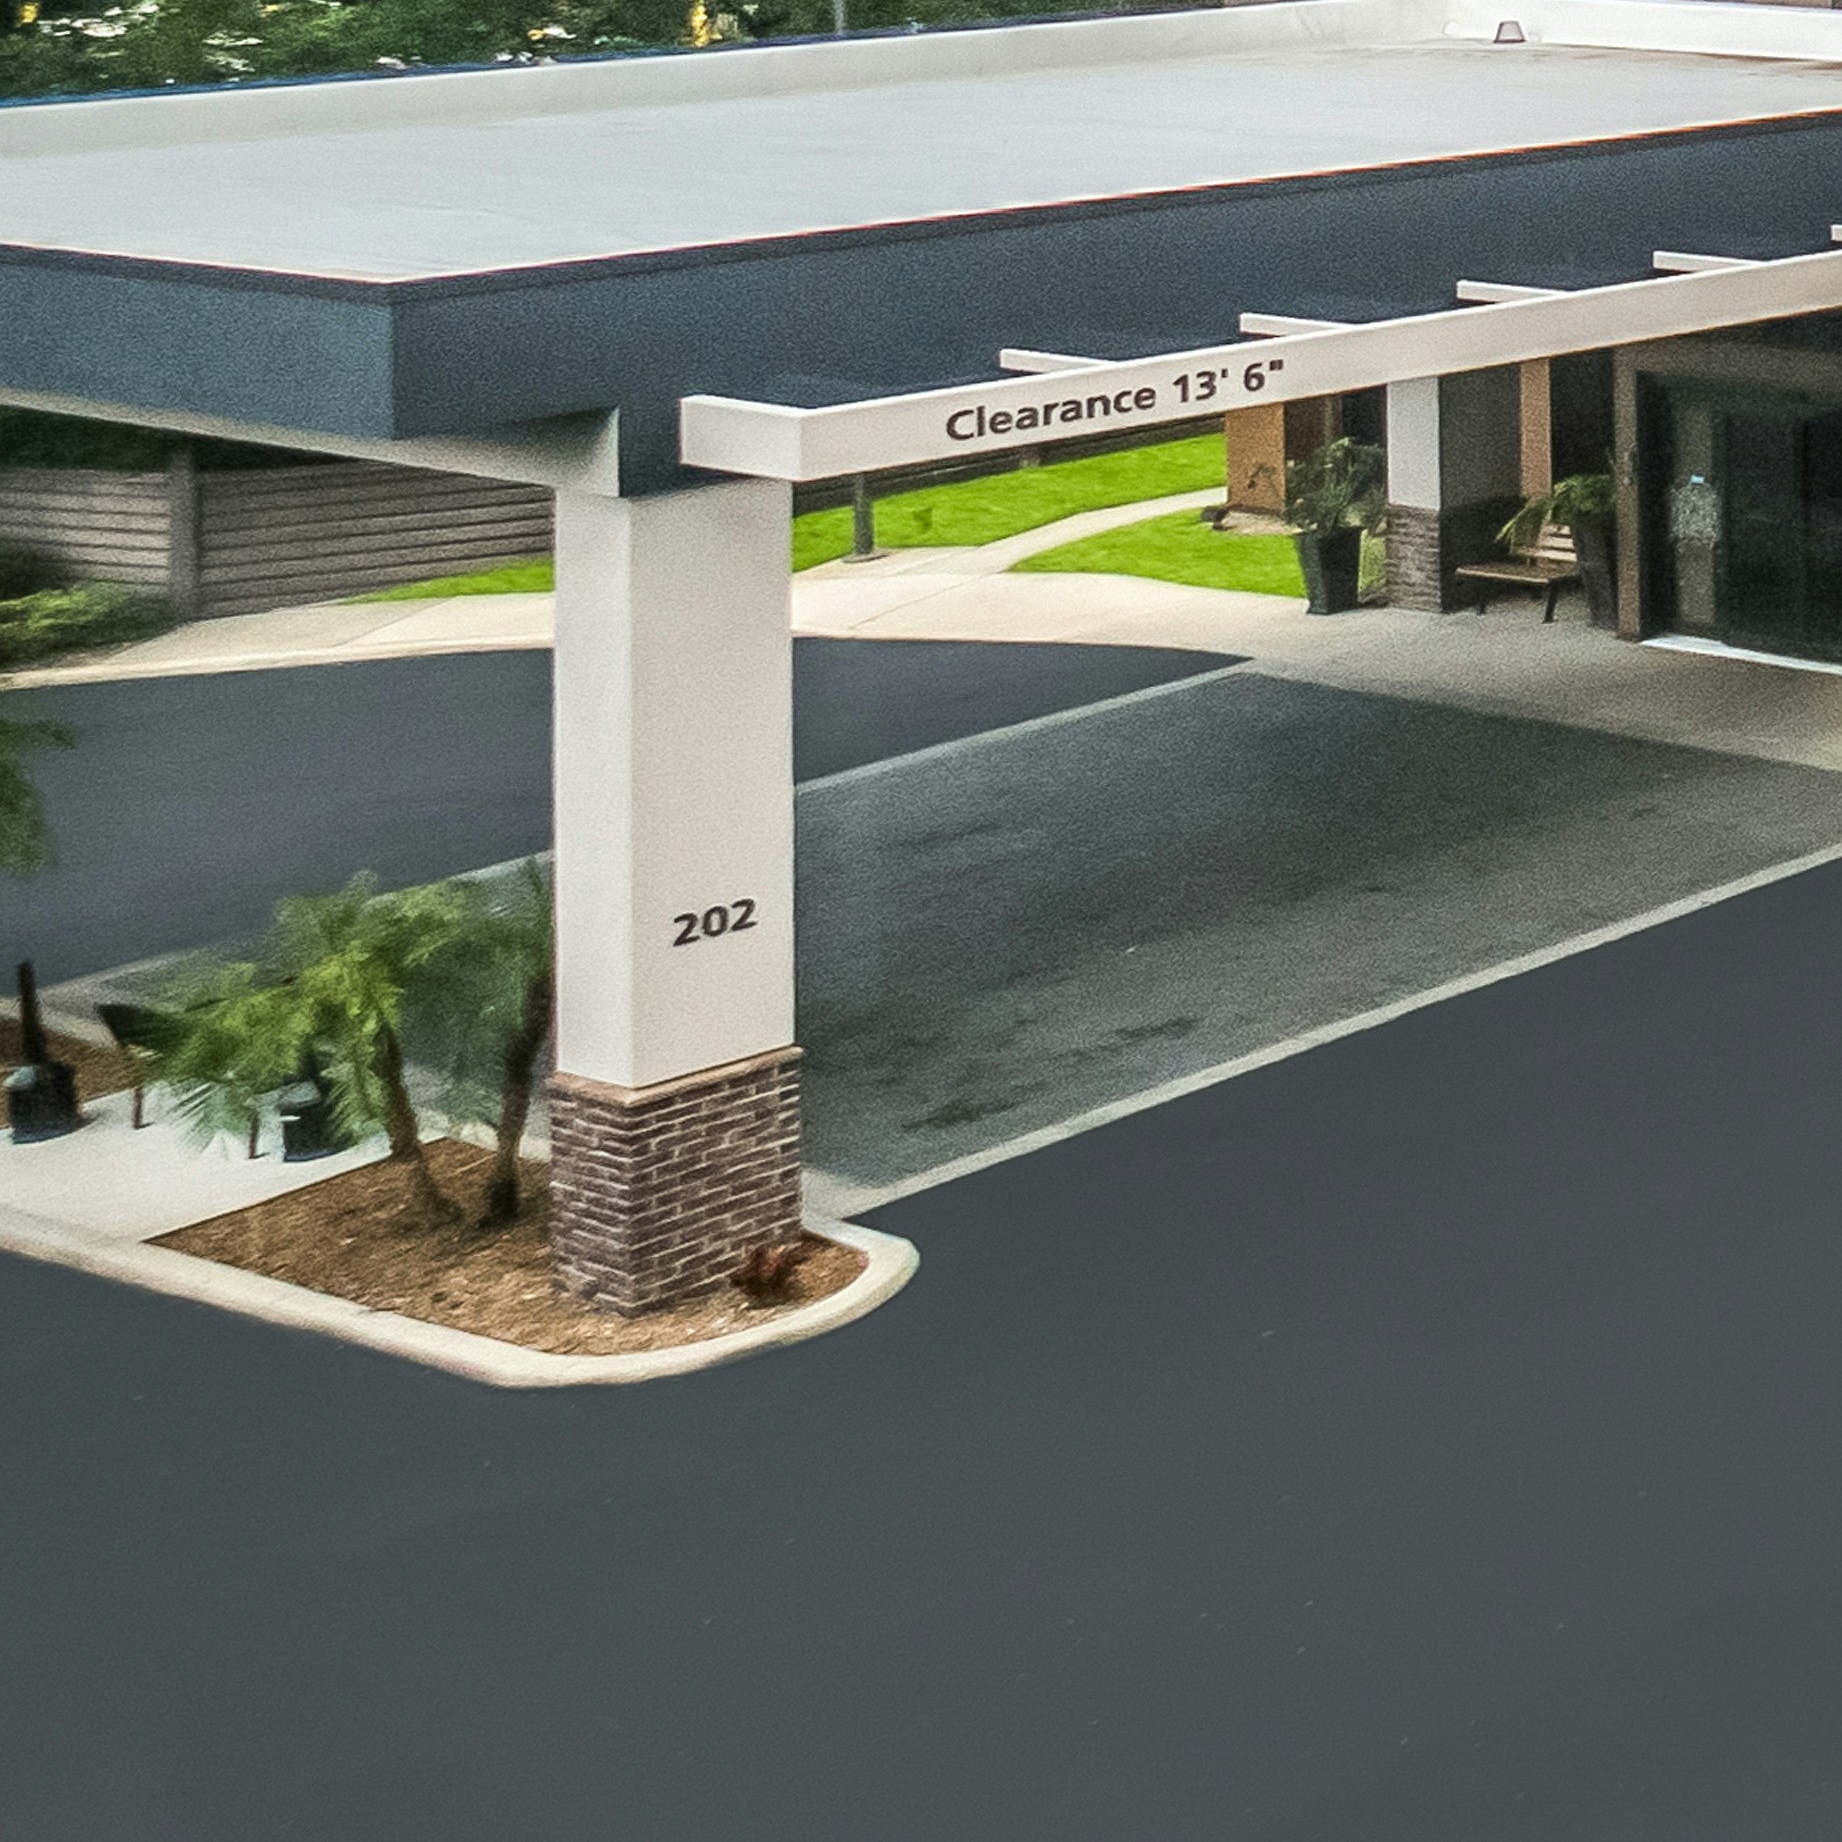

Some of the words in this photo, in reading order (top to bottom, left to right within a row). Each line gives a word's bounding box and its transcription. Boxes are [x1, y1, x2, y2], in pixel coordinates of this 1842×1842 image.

[945, 387, 1156, 441] Clearance
[1172, 368, 1229, 403] 13'
[1243, 359, 1284, 392] 6"
[672, 898, 758, 948] 202
